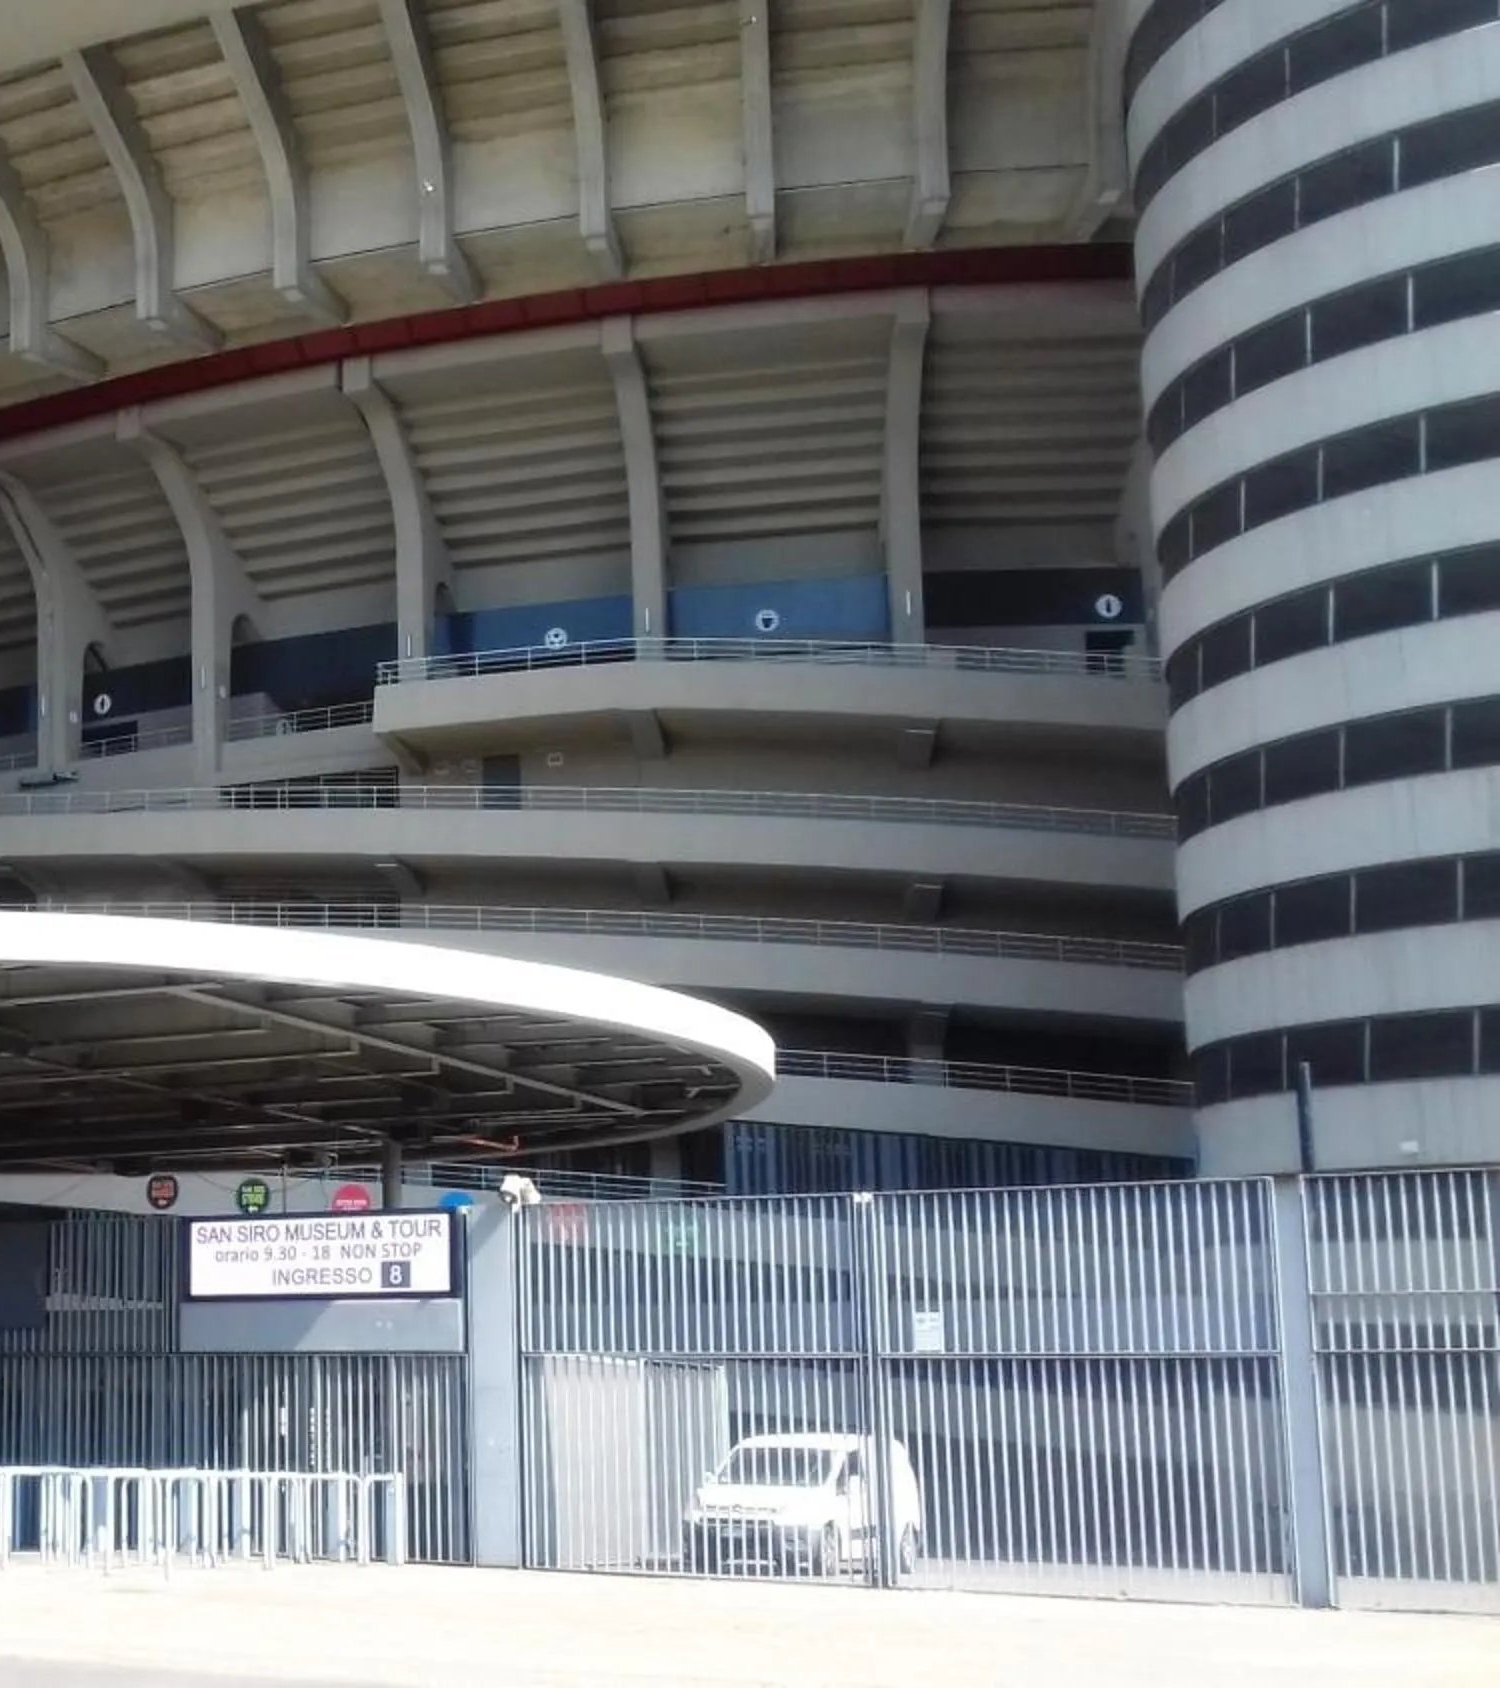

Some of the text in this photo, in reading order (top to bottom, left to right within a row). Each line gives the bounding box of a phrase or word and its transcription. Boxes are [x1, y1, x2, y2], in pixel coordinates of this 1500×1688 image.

[196, 1219, 442, 1244] SAN SIRO MUSEUM & TOUR
[215, 1246, 259, 1263] orario
[263, 1245, 298, 1261] 9.30
[312, 1245, 330, 1261] 18
[340, 1243, 377, 1259] NON
[381, 1242, 423, 1259] STOP
[272, 1264, 403, 1287] INGRESSO 8
